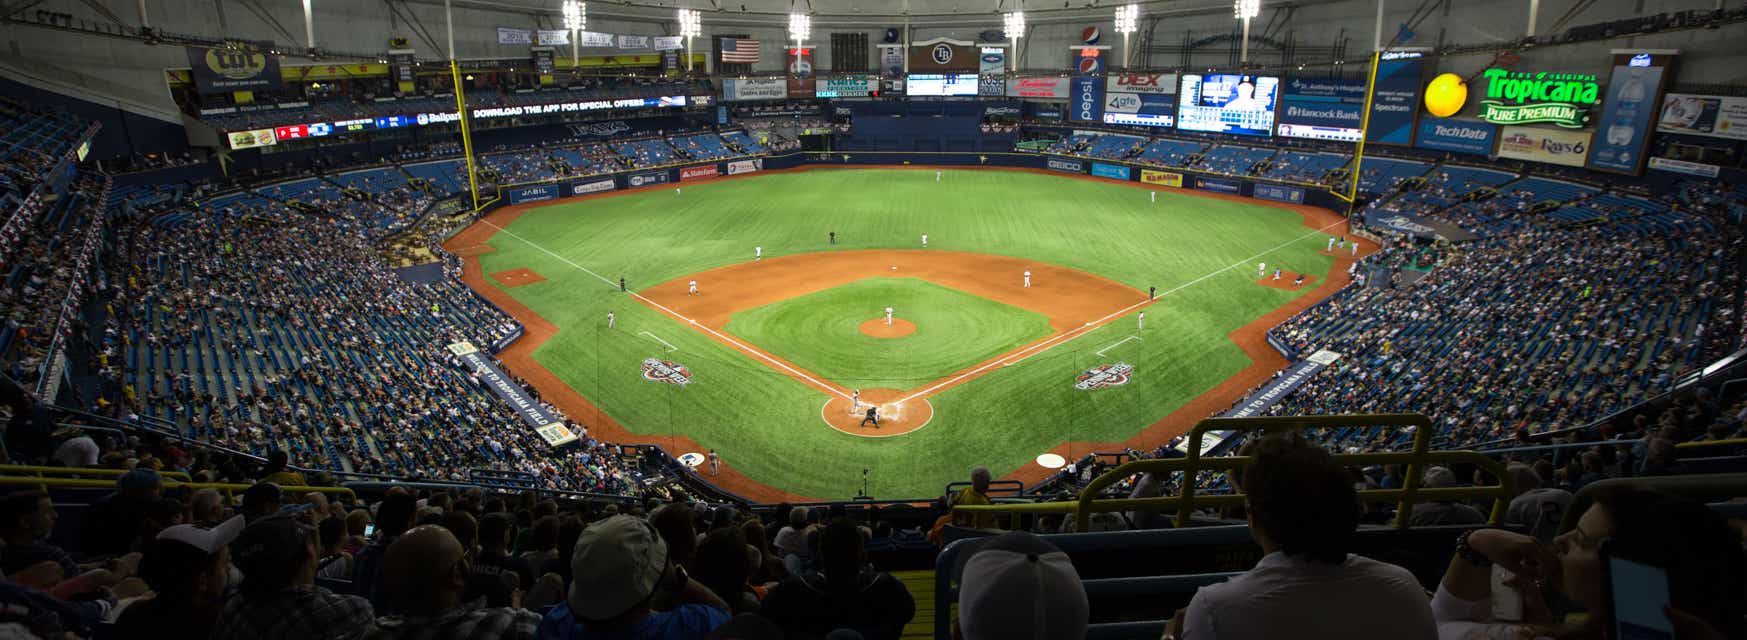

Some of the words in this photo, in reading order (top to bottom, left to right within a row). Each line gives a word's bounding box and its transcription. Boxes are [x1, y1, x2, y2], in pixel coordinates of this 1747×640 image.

[1117, 72, 1162, 87] DEX
[1483, 67, 1599, 104] Tropicana
[473, 107, 522, 119] DOWNLOAD
[523, 105, 542, 114] THE
[543, 104, 560, 113] APP
[561, 103, 579, 112] FOR
[579, 100, 613, 111] SPECIAL
[613, 98, 645, 108] OFFERS
[1081, 81, 1093, 121] pepsi
[1375, 103, 1410, 112] Spectrum
[1297, 107, 1335, 118] Hancock
[1336, 110, 1361, 121] Bank
[1487, 107, 1517, 121] PURE
[1518, 106, 1576, 121] PREMIUM
[1435, 125, 1460, 137] Tech
[1460, 127, 1488, 140] Data
[1573, 141, 1584, 154] 6
[1048, 159, 1081, 171] GEICO
[1250, 399, 1265, 408] TO
[1260, 374, 1301, 401] TROPICANA
[487, 373, 501, 381] TO
[495, 379, 531, 409] TROPICANA
[525, 408, 549, 425] FIELD
